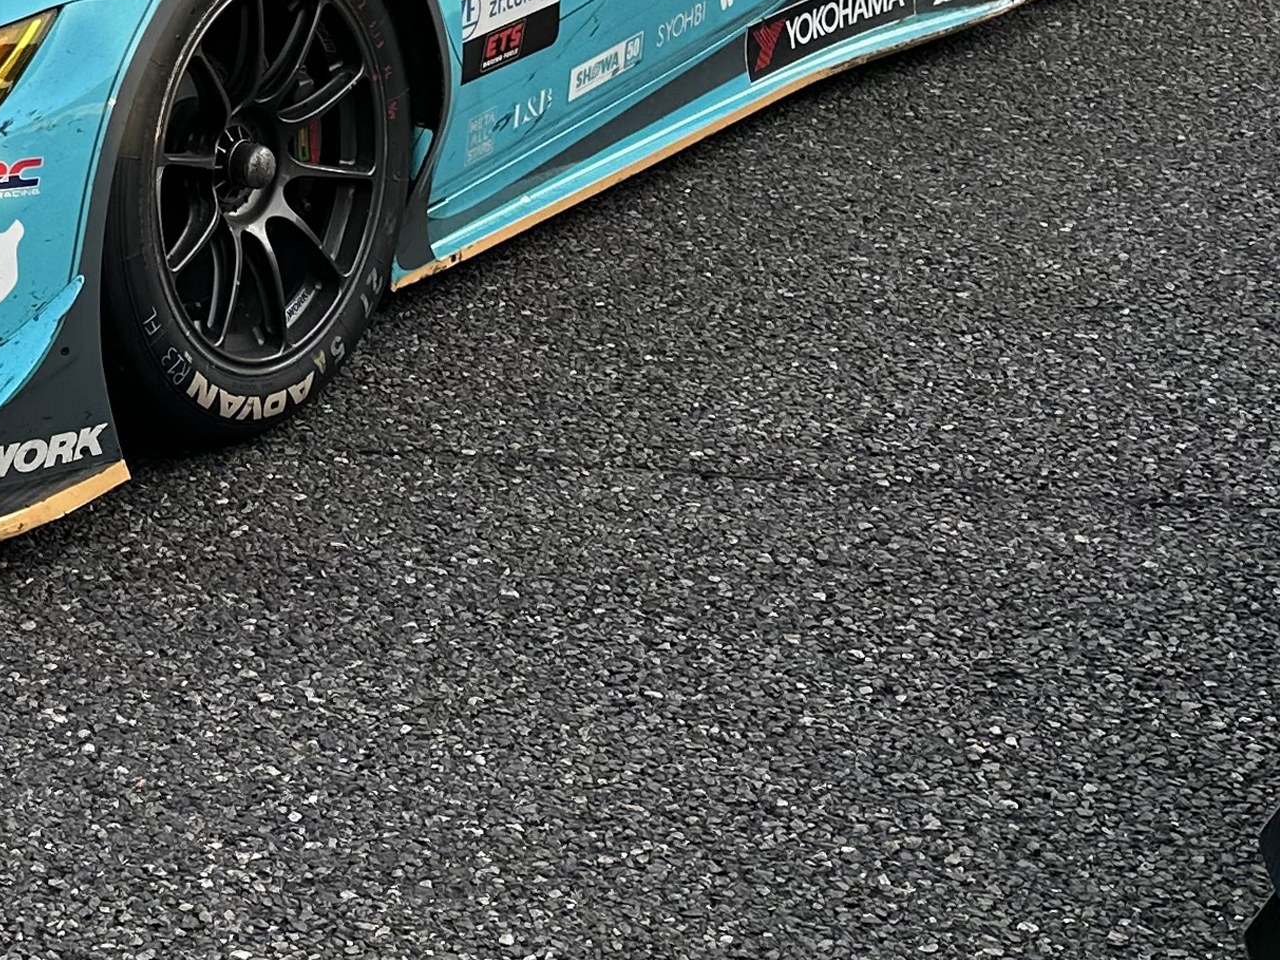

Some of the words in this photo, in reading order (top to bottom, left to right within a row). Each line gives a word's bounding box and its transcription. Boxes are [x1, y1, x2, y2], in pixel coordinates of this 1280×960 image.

[485, 23, 523, 59] ETS
[656, 0, 707, 49] SYOHBI
[185, 370, 316, 421] ADVAN
